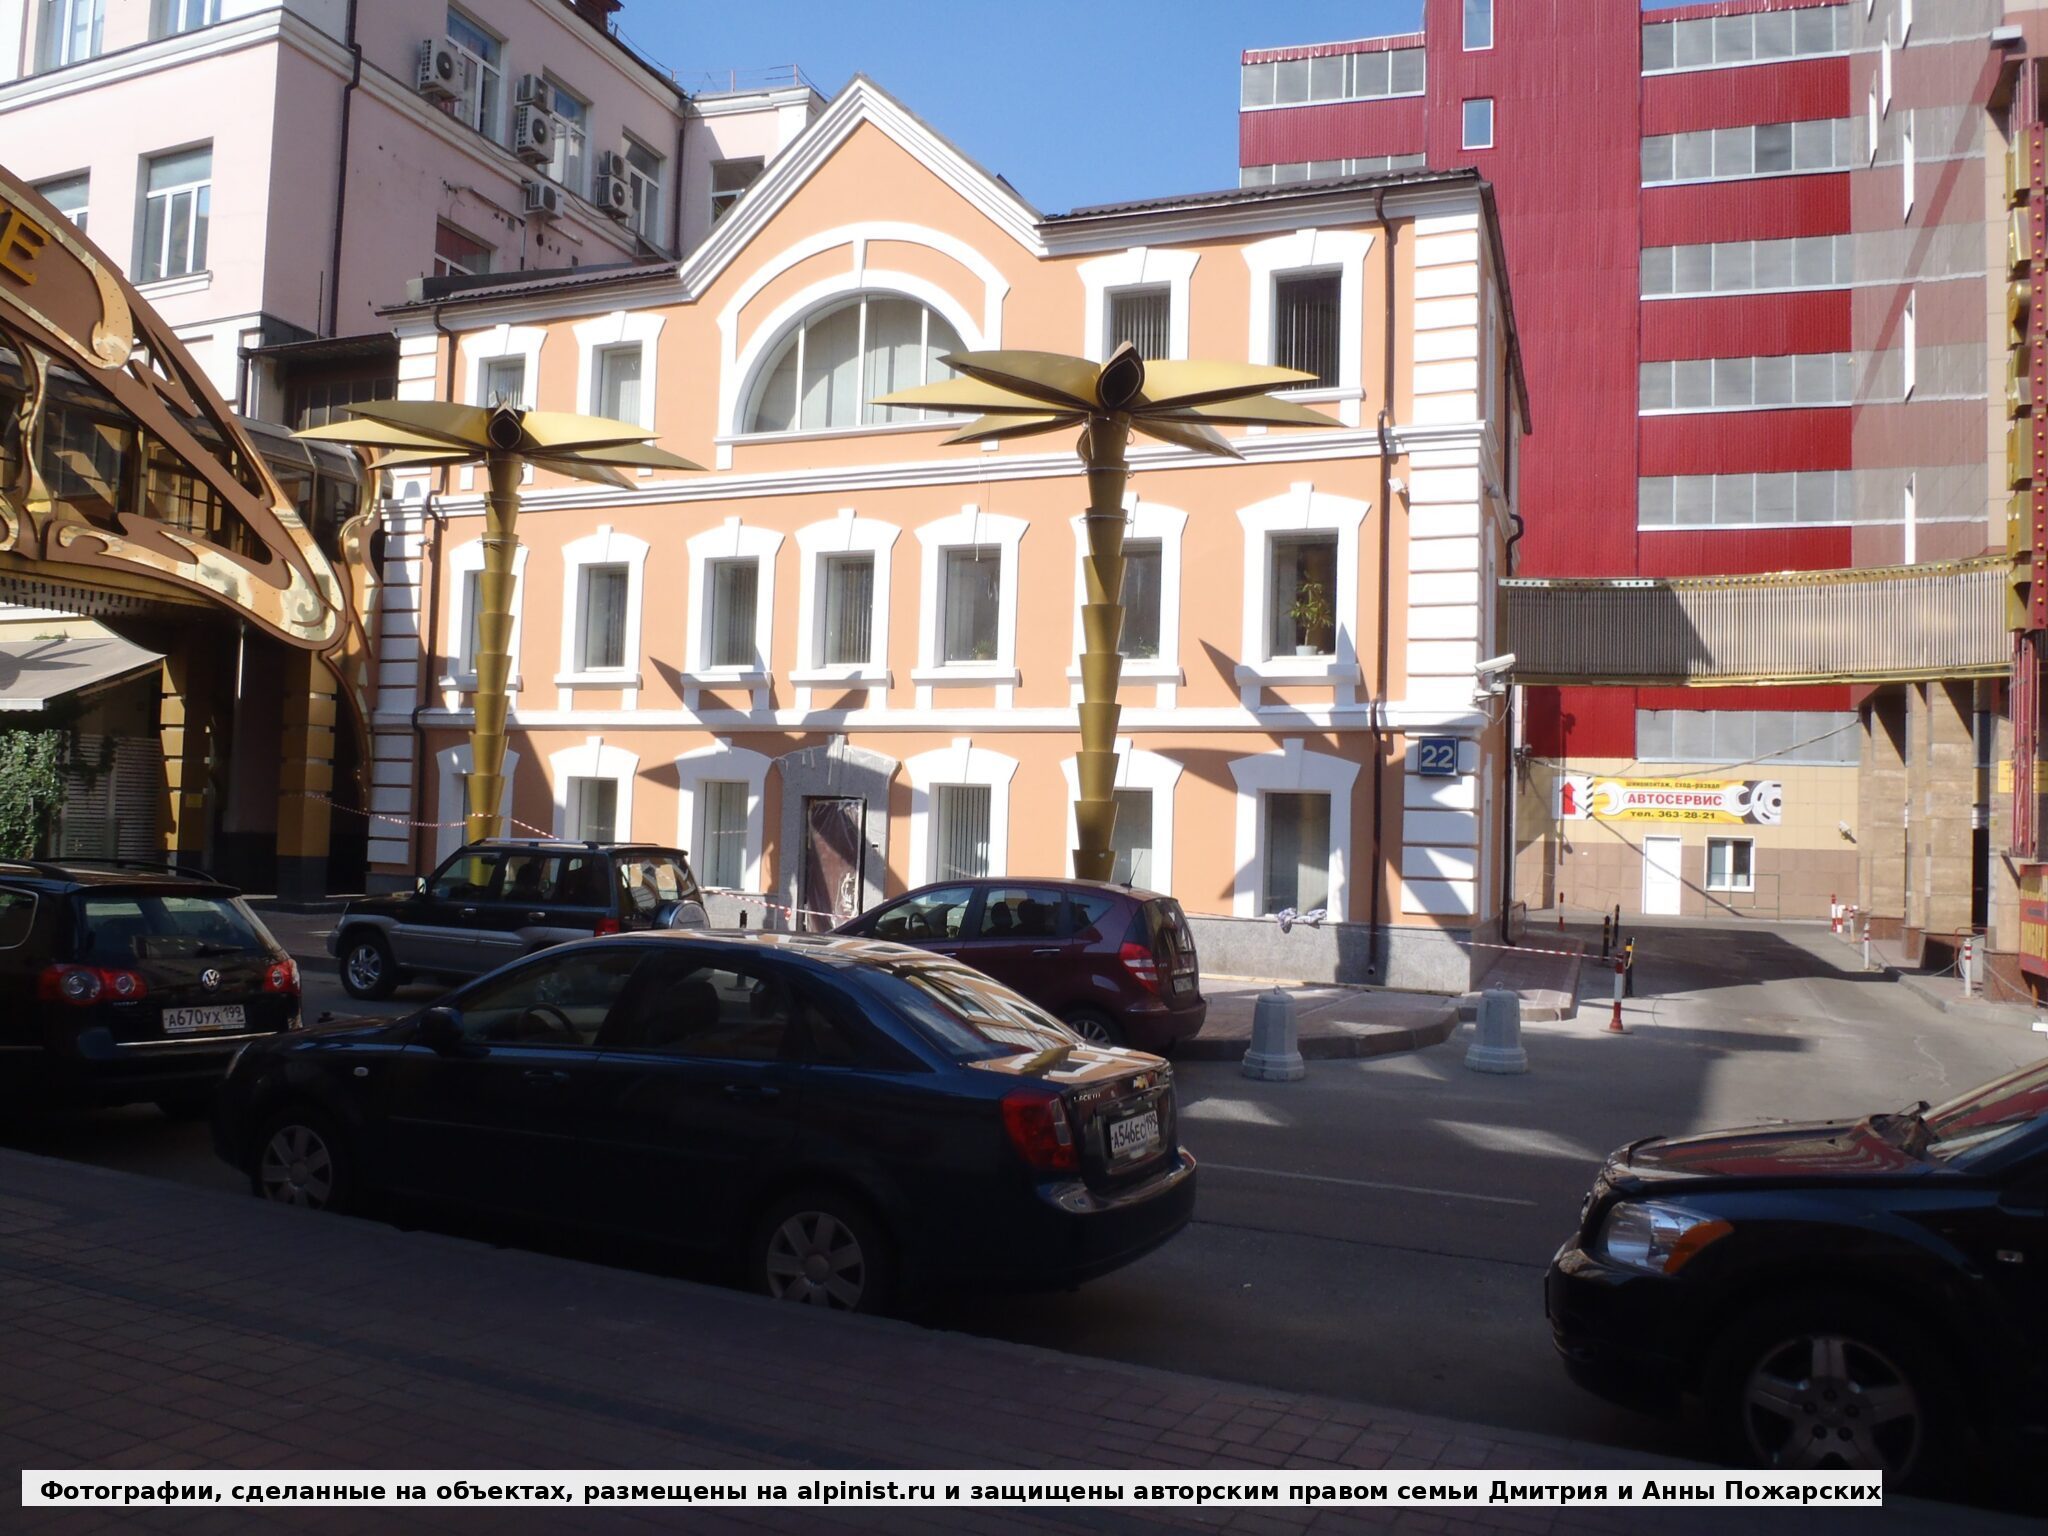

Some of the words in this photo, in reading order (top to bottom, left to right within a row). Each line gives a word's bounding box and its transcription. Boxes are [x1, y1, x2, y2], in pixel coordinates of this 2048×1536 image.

[0, 205, 52, 286] E
[1422, 745, 1454, 768] 22
[1627, 793, 1723, 806] АВТОСЕРВИС
[1658, 811, 1716, 819] 363-28-21
